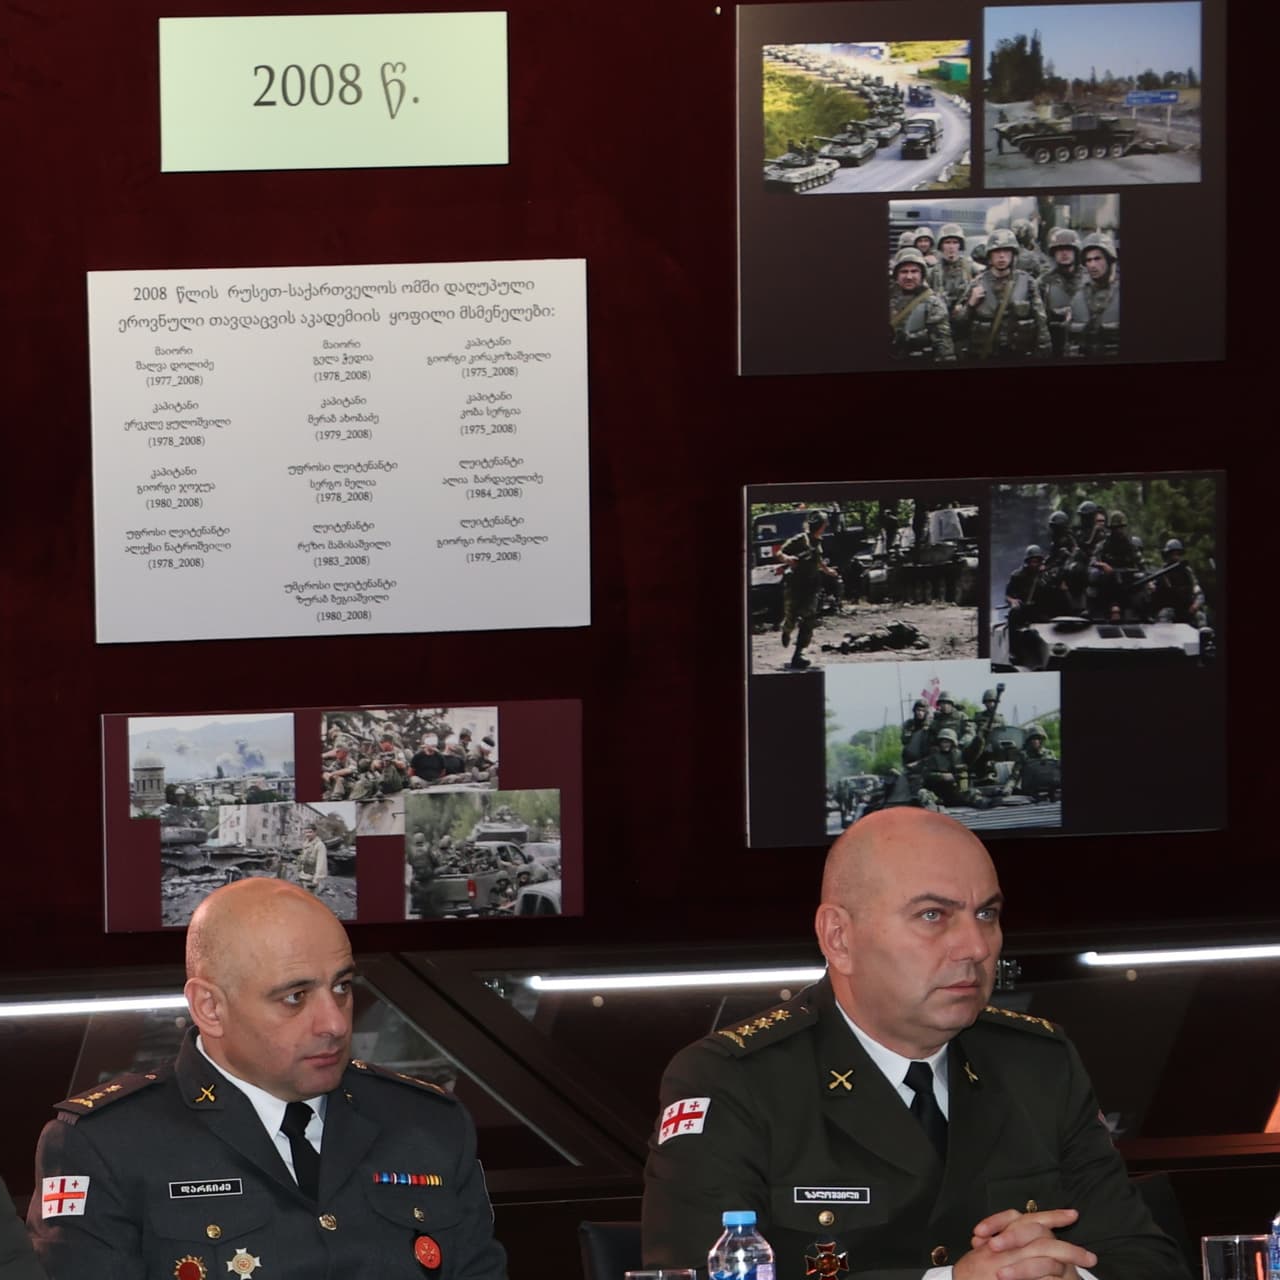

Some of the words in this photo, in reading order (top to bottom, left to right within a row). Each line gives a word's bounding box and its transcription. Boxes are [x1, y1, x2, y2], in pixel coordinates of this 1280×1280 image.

[252, 63, 363, 106] 2008
[380, 62, 419, 119] წ.
[133, 287, 167, 301] 2008
[176, 285, 219, 304] წლის
[228, 280, 397, 303] რუსეთ-საქართველოს
[401, 280, 440, 293] ომში
[444, 279, 535, 296] დაღუპული
[118, 314, 204, 333] ეროვნული
[209, 310, 296, 330] თავდაცვის
[300, 308, 381, 328] აკადემიის
[389, 310, 455, 326] ყოფილი
[460, 304, 555, 323] მსმენელები:
